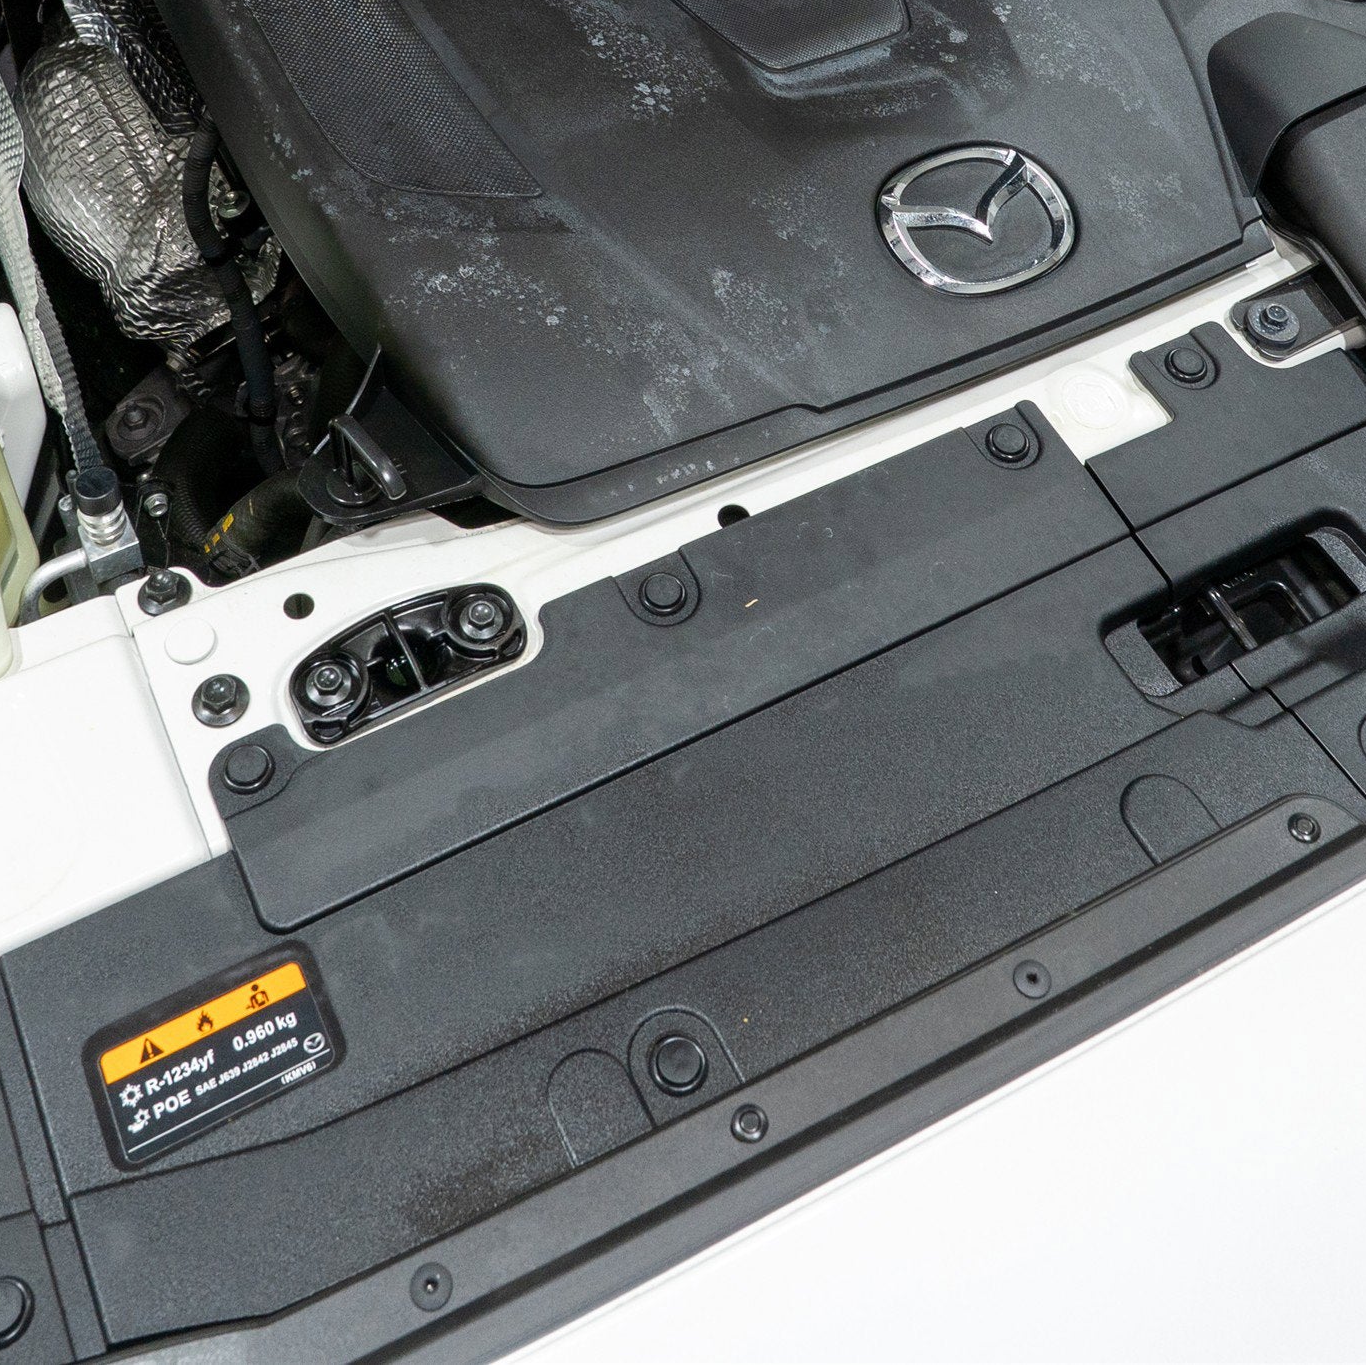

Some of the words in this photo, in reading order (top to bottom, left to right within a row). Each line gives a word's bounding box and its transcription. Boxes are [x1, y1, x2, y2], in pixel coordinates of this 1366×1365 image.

[143, 1048, 216, 1097] R-1234yf
[231, 1021, 275, 1052] 0.960
[276, 1011, 299, 1030] kg
[152, 1089, 193, 1121] POE
[195, 1078, 218, 1098] SAE
[218, 1066, 242, 1087] J639
